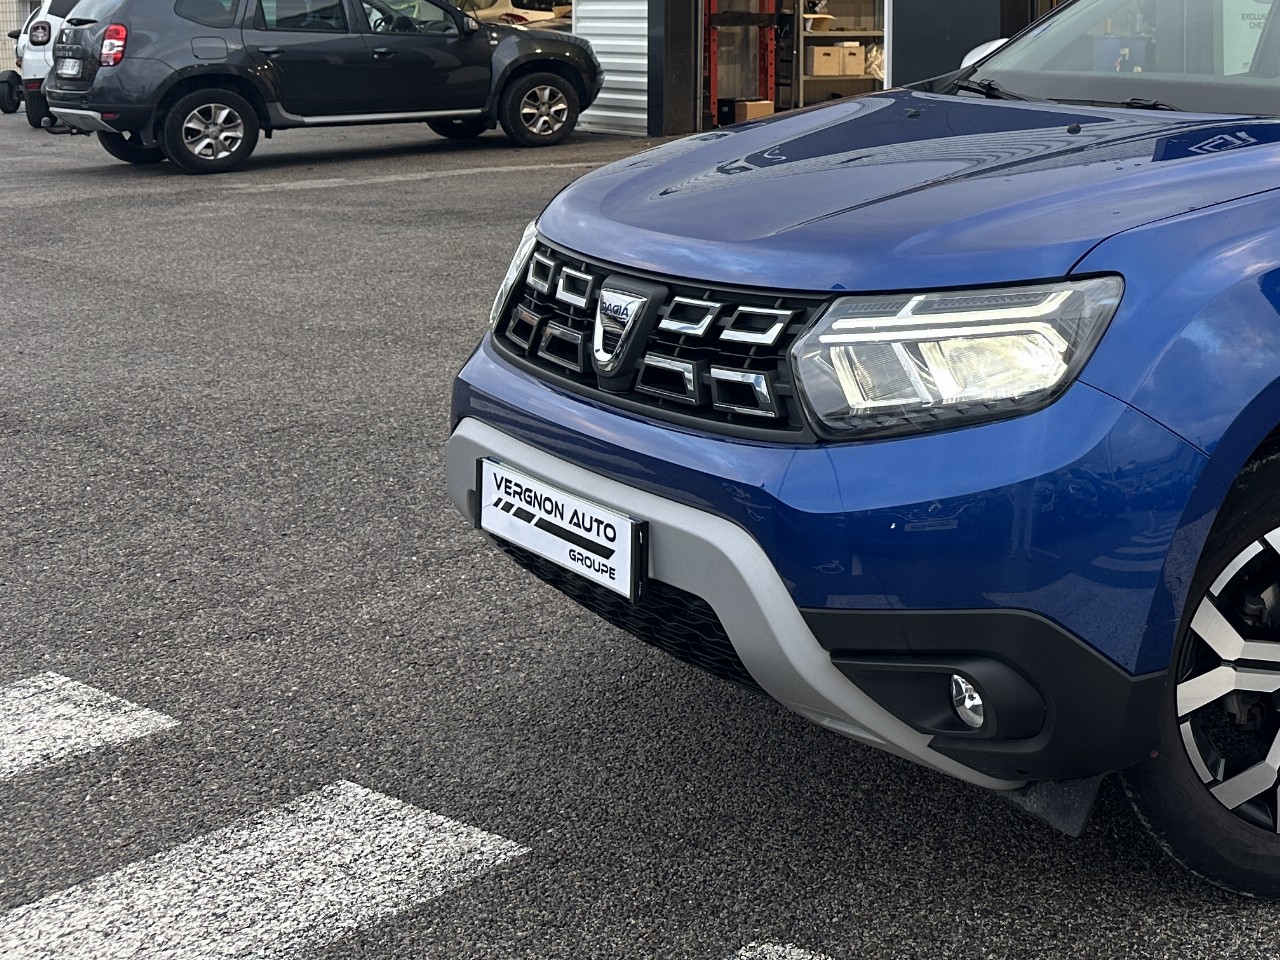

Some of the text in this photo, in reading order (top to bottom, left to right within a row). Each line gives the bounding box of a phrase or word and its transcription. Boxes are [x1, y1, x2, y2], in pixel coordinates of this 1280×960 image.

[600, 302, 629, 318] DACIA
[492, 473, 617, 543] VERGNON AUTO
[568, 548, 617, 581] GROUPE
